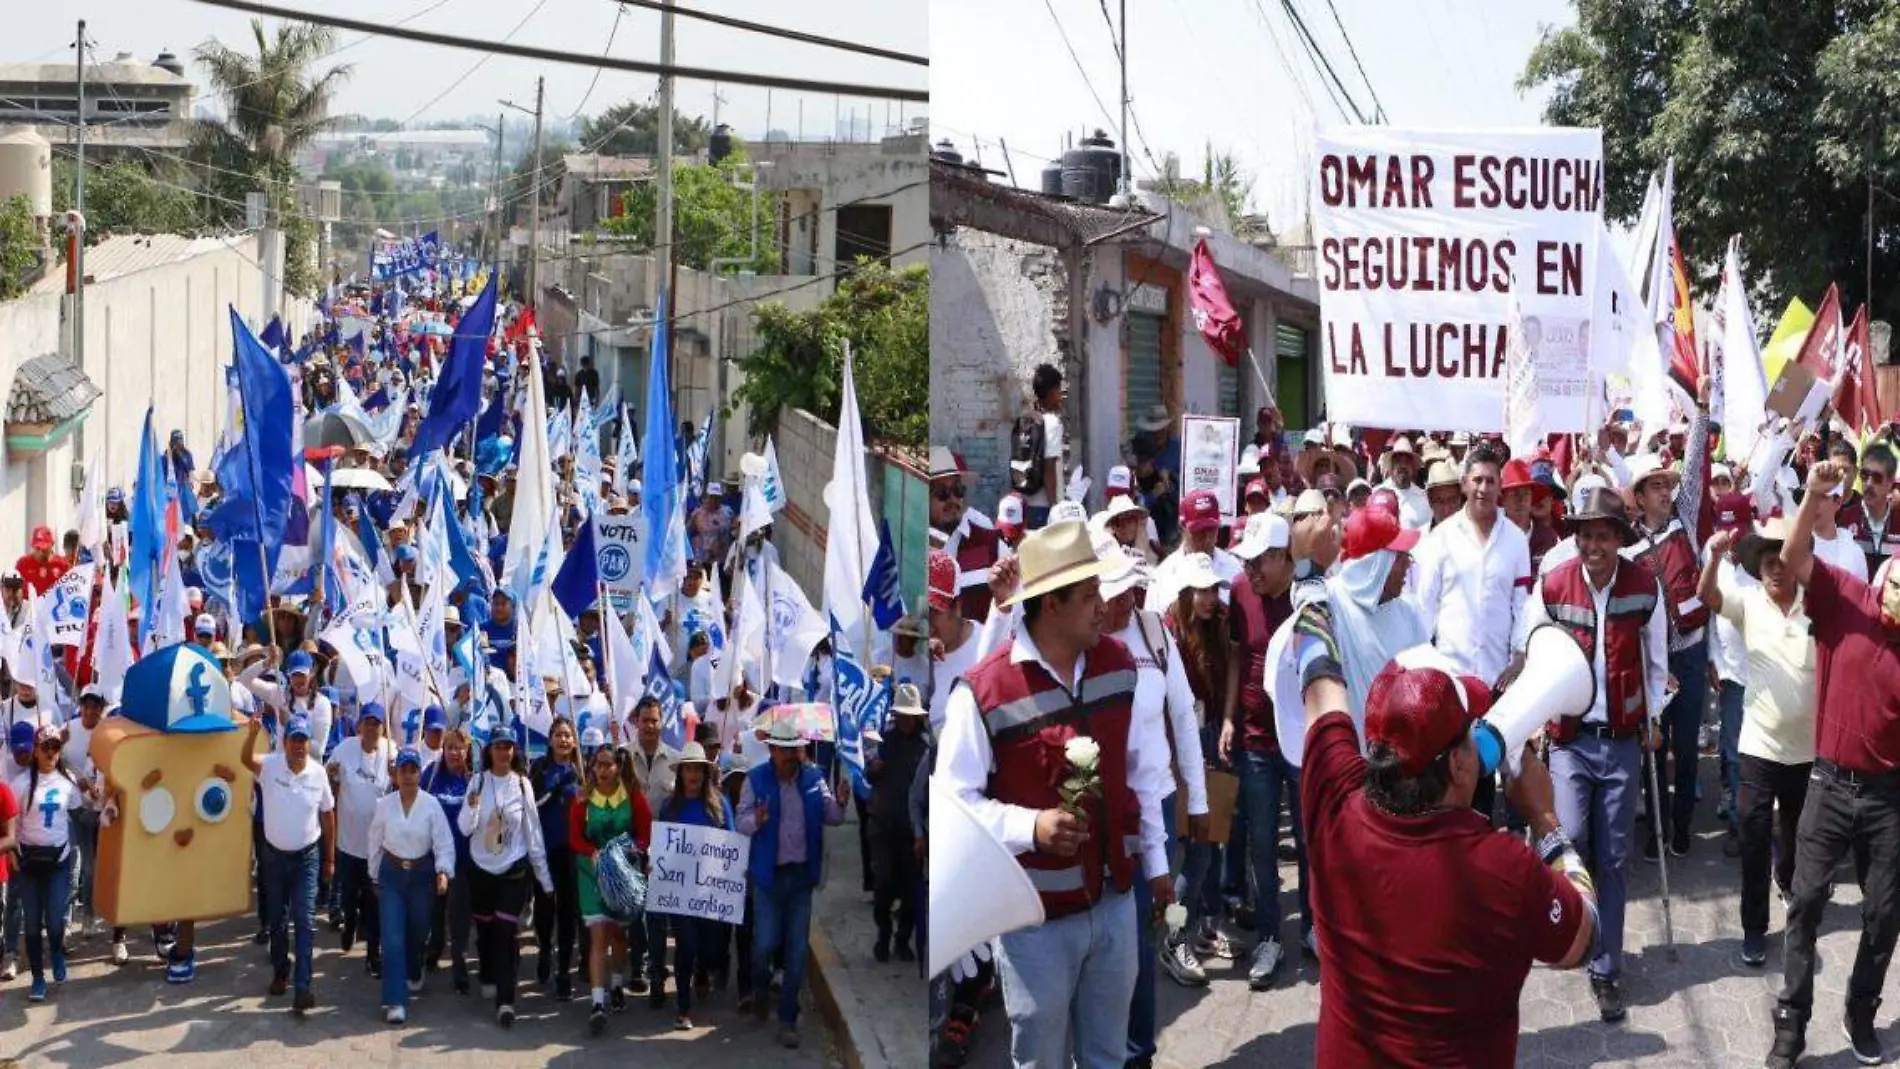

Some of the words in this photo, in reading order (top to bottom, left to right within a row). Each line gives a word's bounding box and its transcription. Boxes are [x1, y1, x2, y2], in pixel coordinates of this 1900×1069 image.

[1320, 154, 1434, 208] OMAR
[1322, 237, 1516, 293] SEGUIMOS
[1536, 241, 1583, 296] EN
[1328, 321, 1368, 375] LA
[1384, 322, 1506, 378] LUCHA
[599, 524, 638, 543] VOTA
[601, 552, 628, 571] PAN
[701, 843, 740, 870] amigo
[657, 856, 684, 888] San
[695, 861, 743, 893] Lorenzo
[688, 894, 734, 919] contigo
